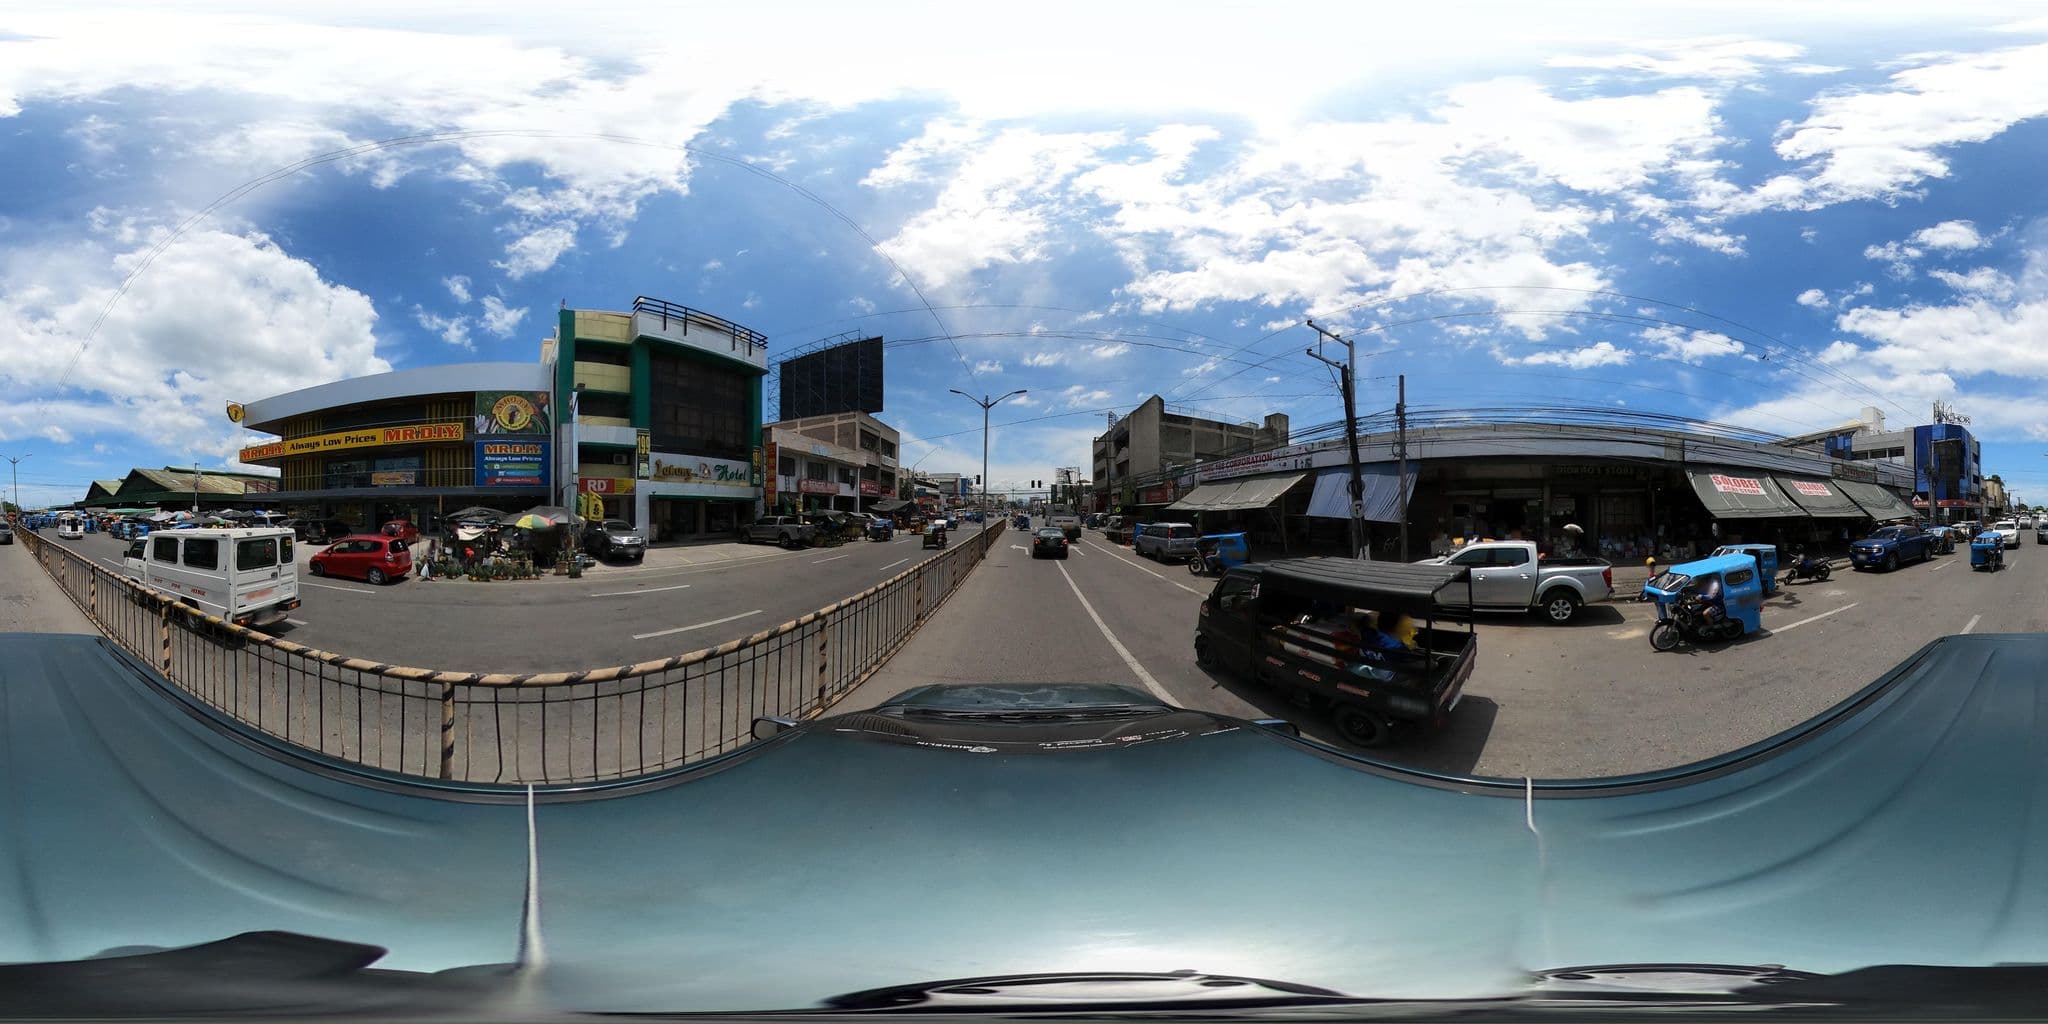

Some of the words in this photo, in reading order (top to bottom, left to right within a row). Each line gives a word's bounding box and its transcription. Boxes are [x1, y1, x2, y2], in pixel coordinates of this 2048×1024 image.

[290, 441, 320, 450] Always
[323, 438, 341, 447] Low
[345, 434, 376, 444] Prices
[715, 464, 747, 481] Hotel
